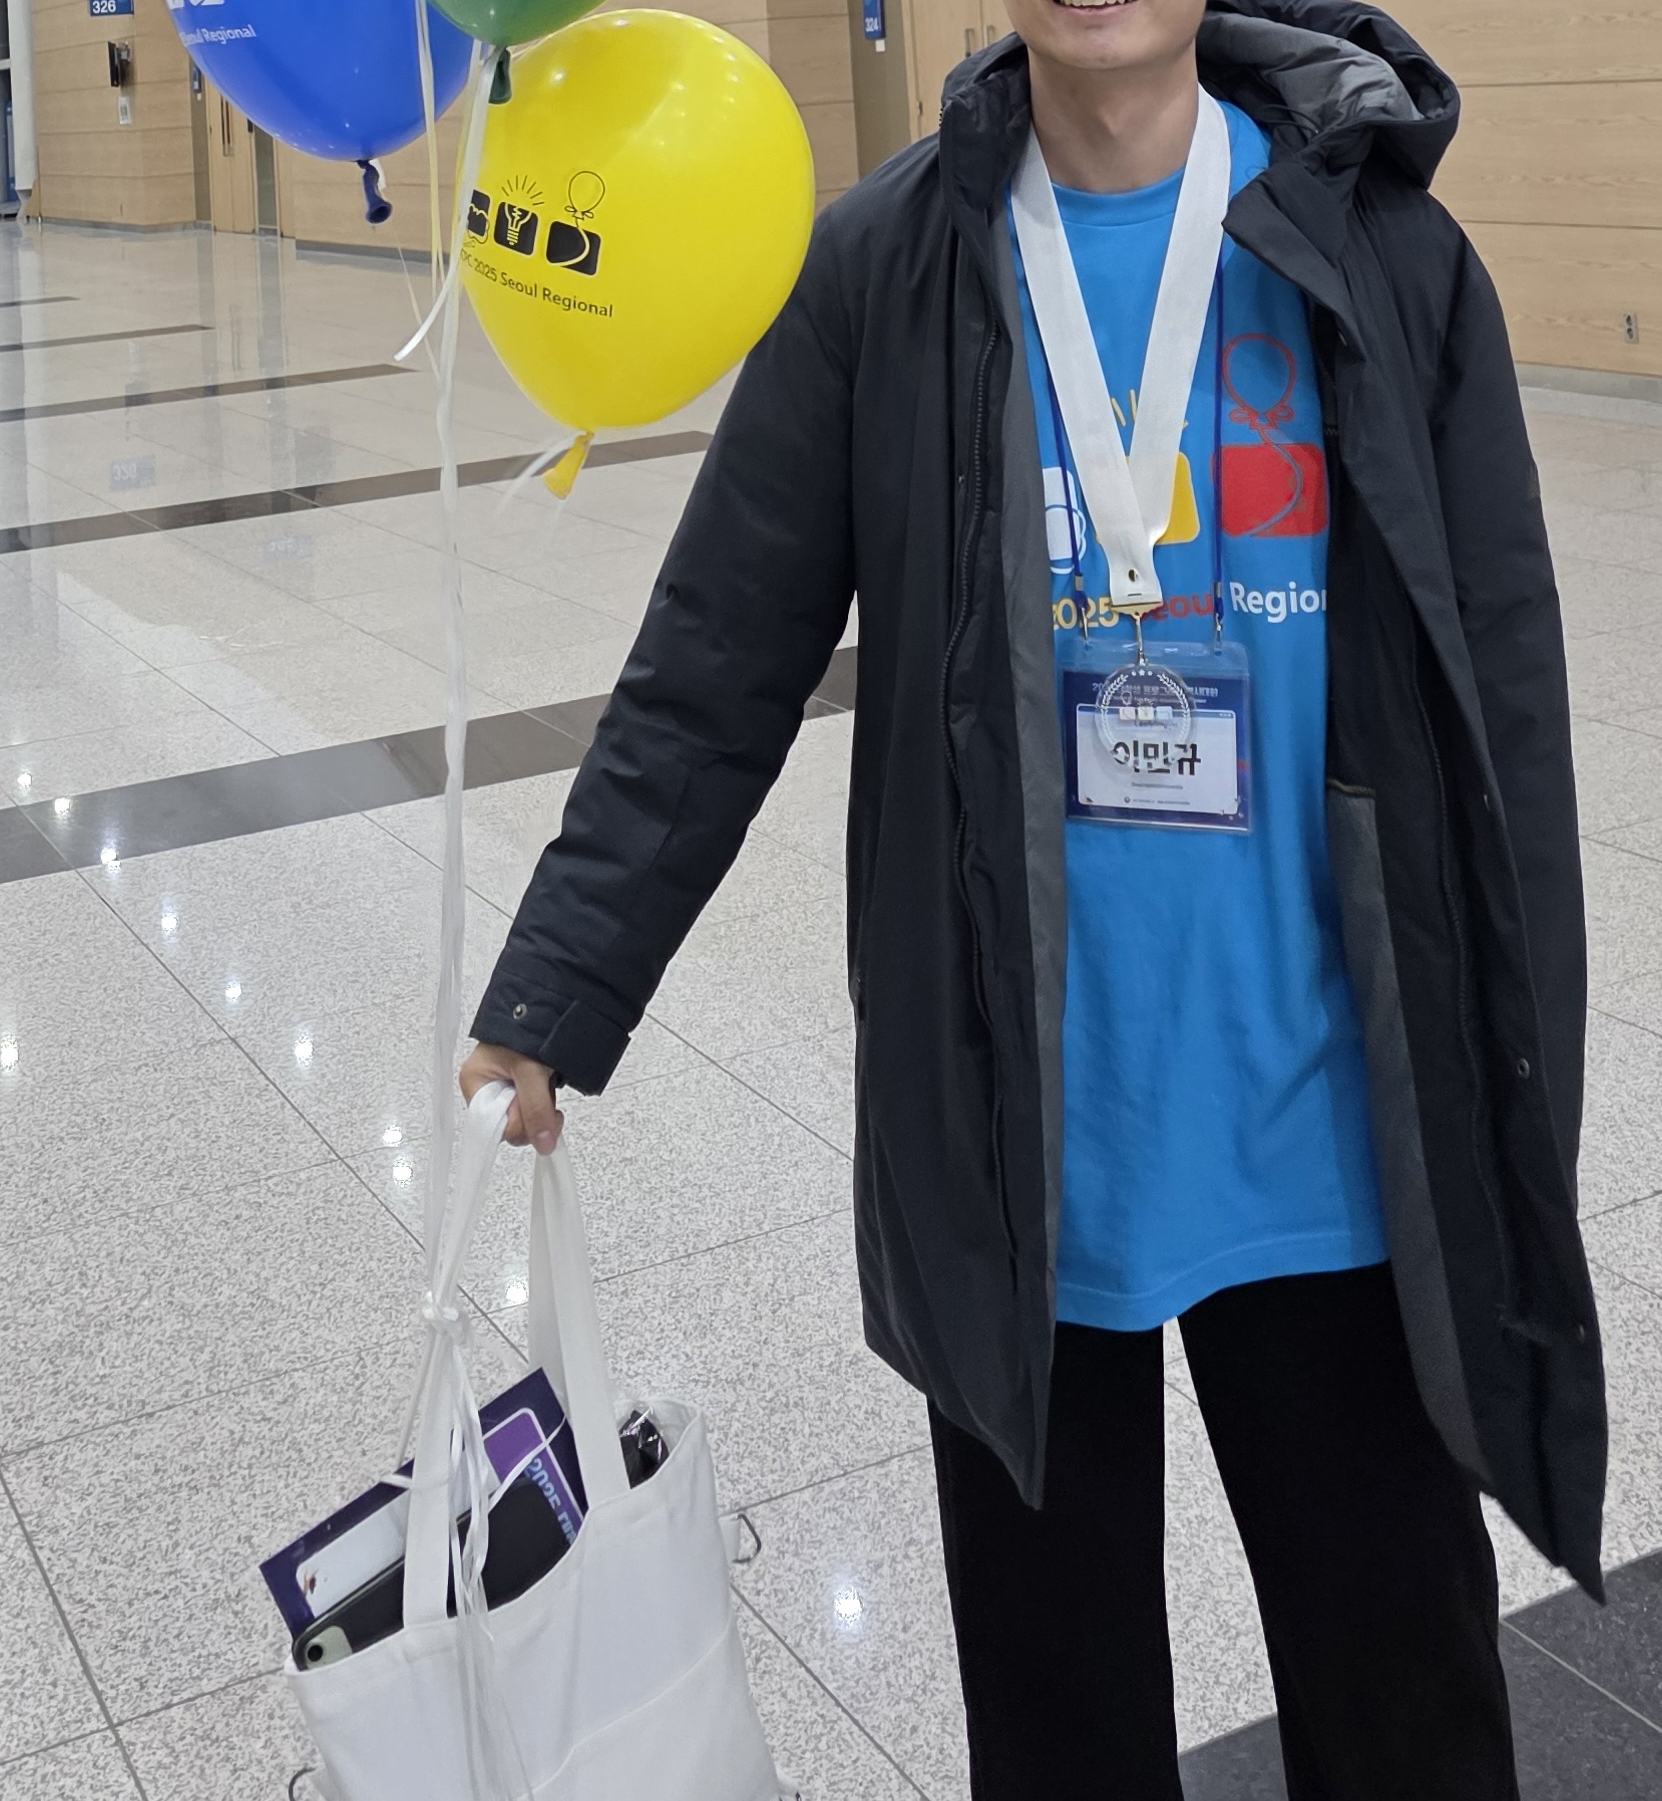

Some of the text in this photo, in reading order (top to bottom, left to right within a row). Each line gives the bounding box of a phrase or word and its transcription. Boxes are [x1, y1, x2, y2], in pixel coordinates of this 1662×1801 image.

[92, 0, 116, 14] 326
[201, 24, 257, 45] Regional
[865, 17, 879, 32] 324
[500, 271, 538, 298] Seoul
[542, 287, 613, 317] Regional
[1229, 581, 1327, 624] Regio
